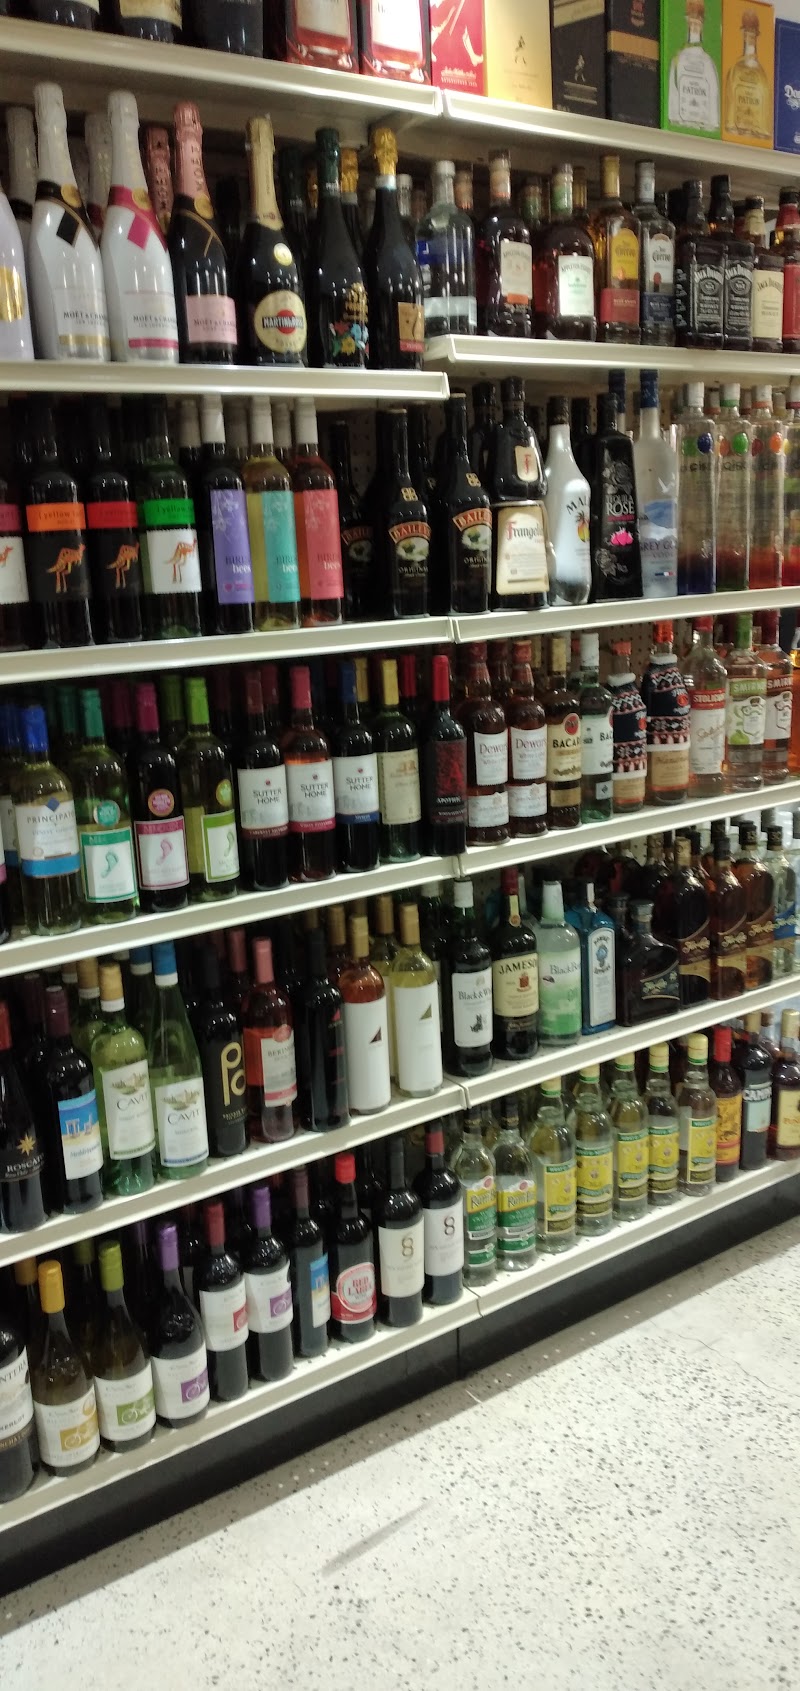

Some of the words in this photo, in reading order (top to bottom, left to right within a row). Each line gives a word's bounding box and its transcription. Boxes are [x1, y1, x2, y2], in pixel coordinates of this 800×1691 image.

[606, 501, 635, 517] ROSE
[346, 776, 373, 786] SUTTER
[253, 787, 282, 797] SUTTER
[300, 782, 329, 792] SUTTER
[350, 783, 371, 792] HOME
[304, 790, 327, 799] HOME
[257, 796, 281, 805] HOME
[167, 1109, 200, 1126] CAVIT
[444, 1216, 456, 1236] 8
[402, 1237, 414, 1257] 8
[352, 1275, 369, 1287] RED
